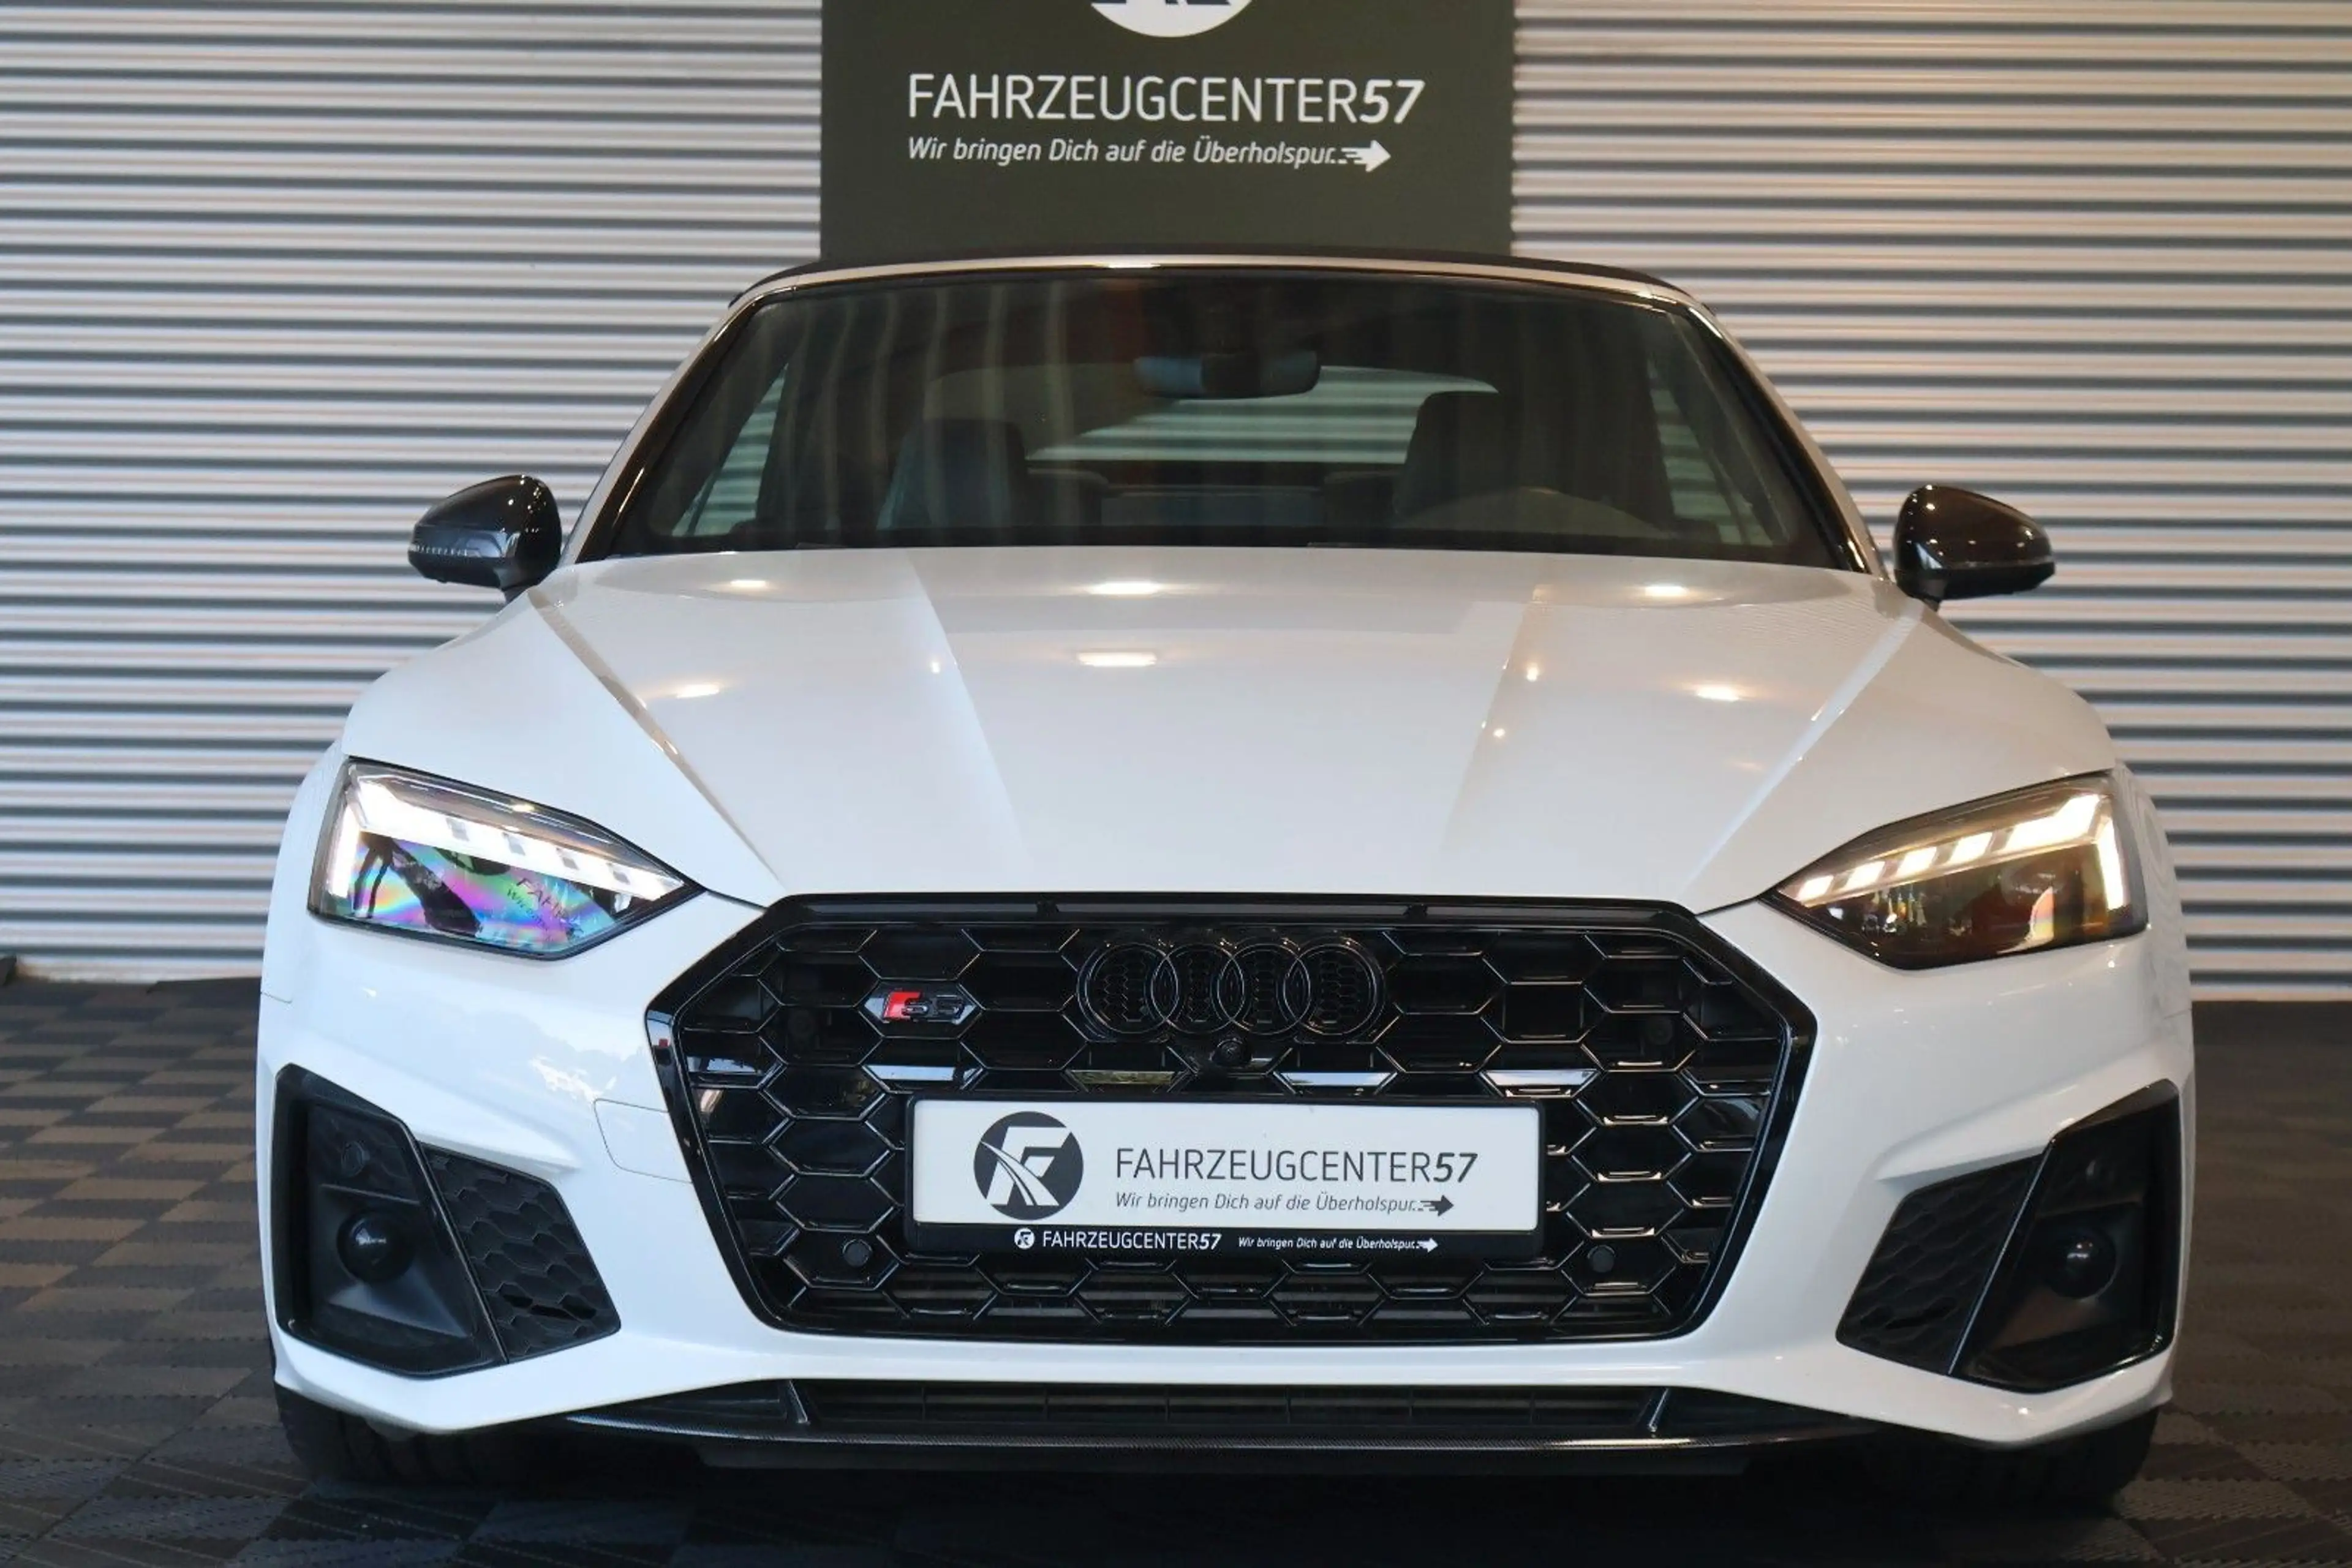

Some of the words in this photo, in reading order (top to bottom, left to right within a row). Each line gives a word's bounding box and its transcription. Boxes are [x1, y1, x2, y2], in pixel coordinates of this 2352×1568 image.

[909, 73, 1426, 124] FAHRZEUGCENTER57
[909, 136, 947, 159] Wir
[953, 137, 1041, 166] bringen
[1049, 138, 1098, 161] Dich
[1106, 139, 1146, 162] auf
[1151, 140, 1186, 162] die
[1116, 1148, 1479, 1183] FAHRZEUGCENTER57
[1116, 1192, 1142, 1208] Wir
[1147, 1193, 1208, 1212] bringen
[1215, 1193, 1250, 1209] Dich
[1254, 1194, 1282, 1210] auf
[1286, 1196, 1311, 1211] die
[1043, 1231, 1223, 1250] FAHRZEUGCENTER57
[1238, 1237, 1255, 1248] Wir
[1257, 1237, 1293, 1251] bringen
[1296, 1237, 1317, 1248] Dich
[1320, 1238, 1338, 1249] auf
[1340, 1238, 1353, 1249] die
